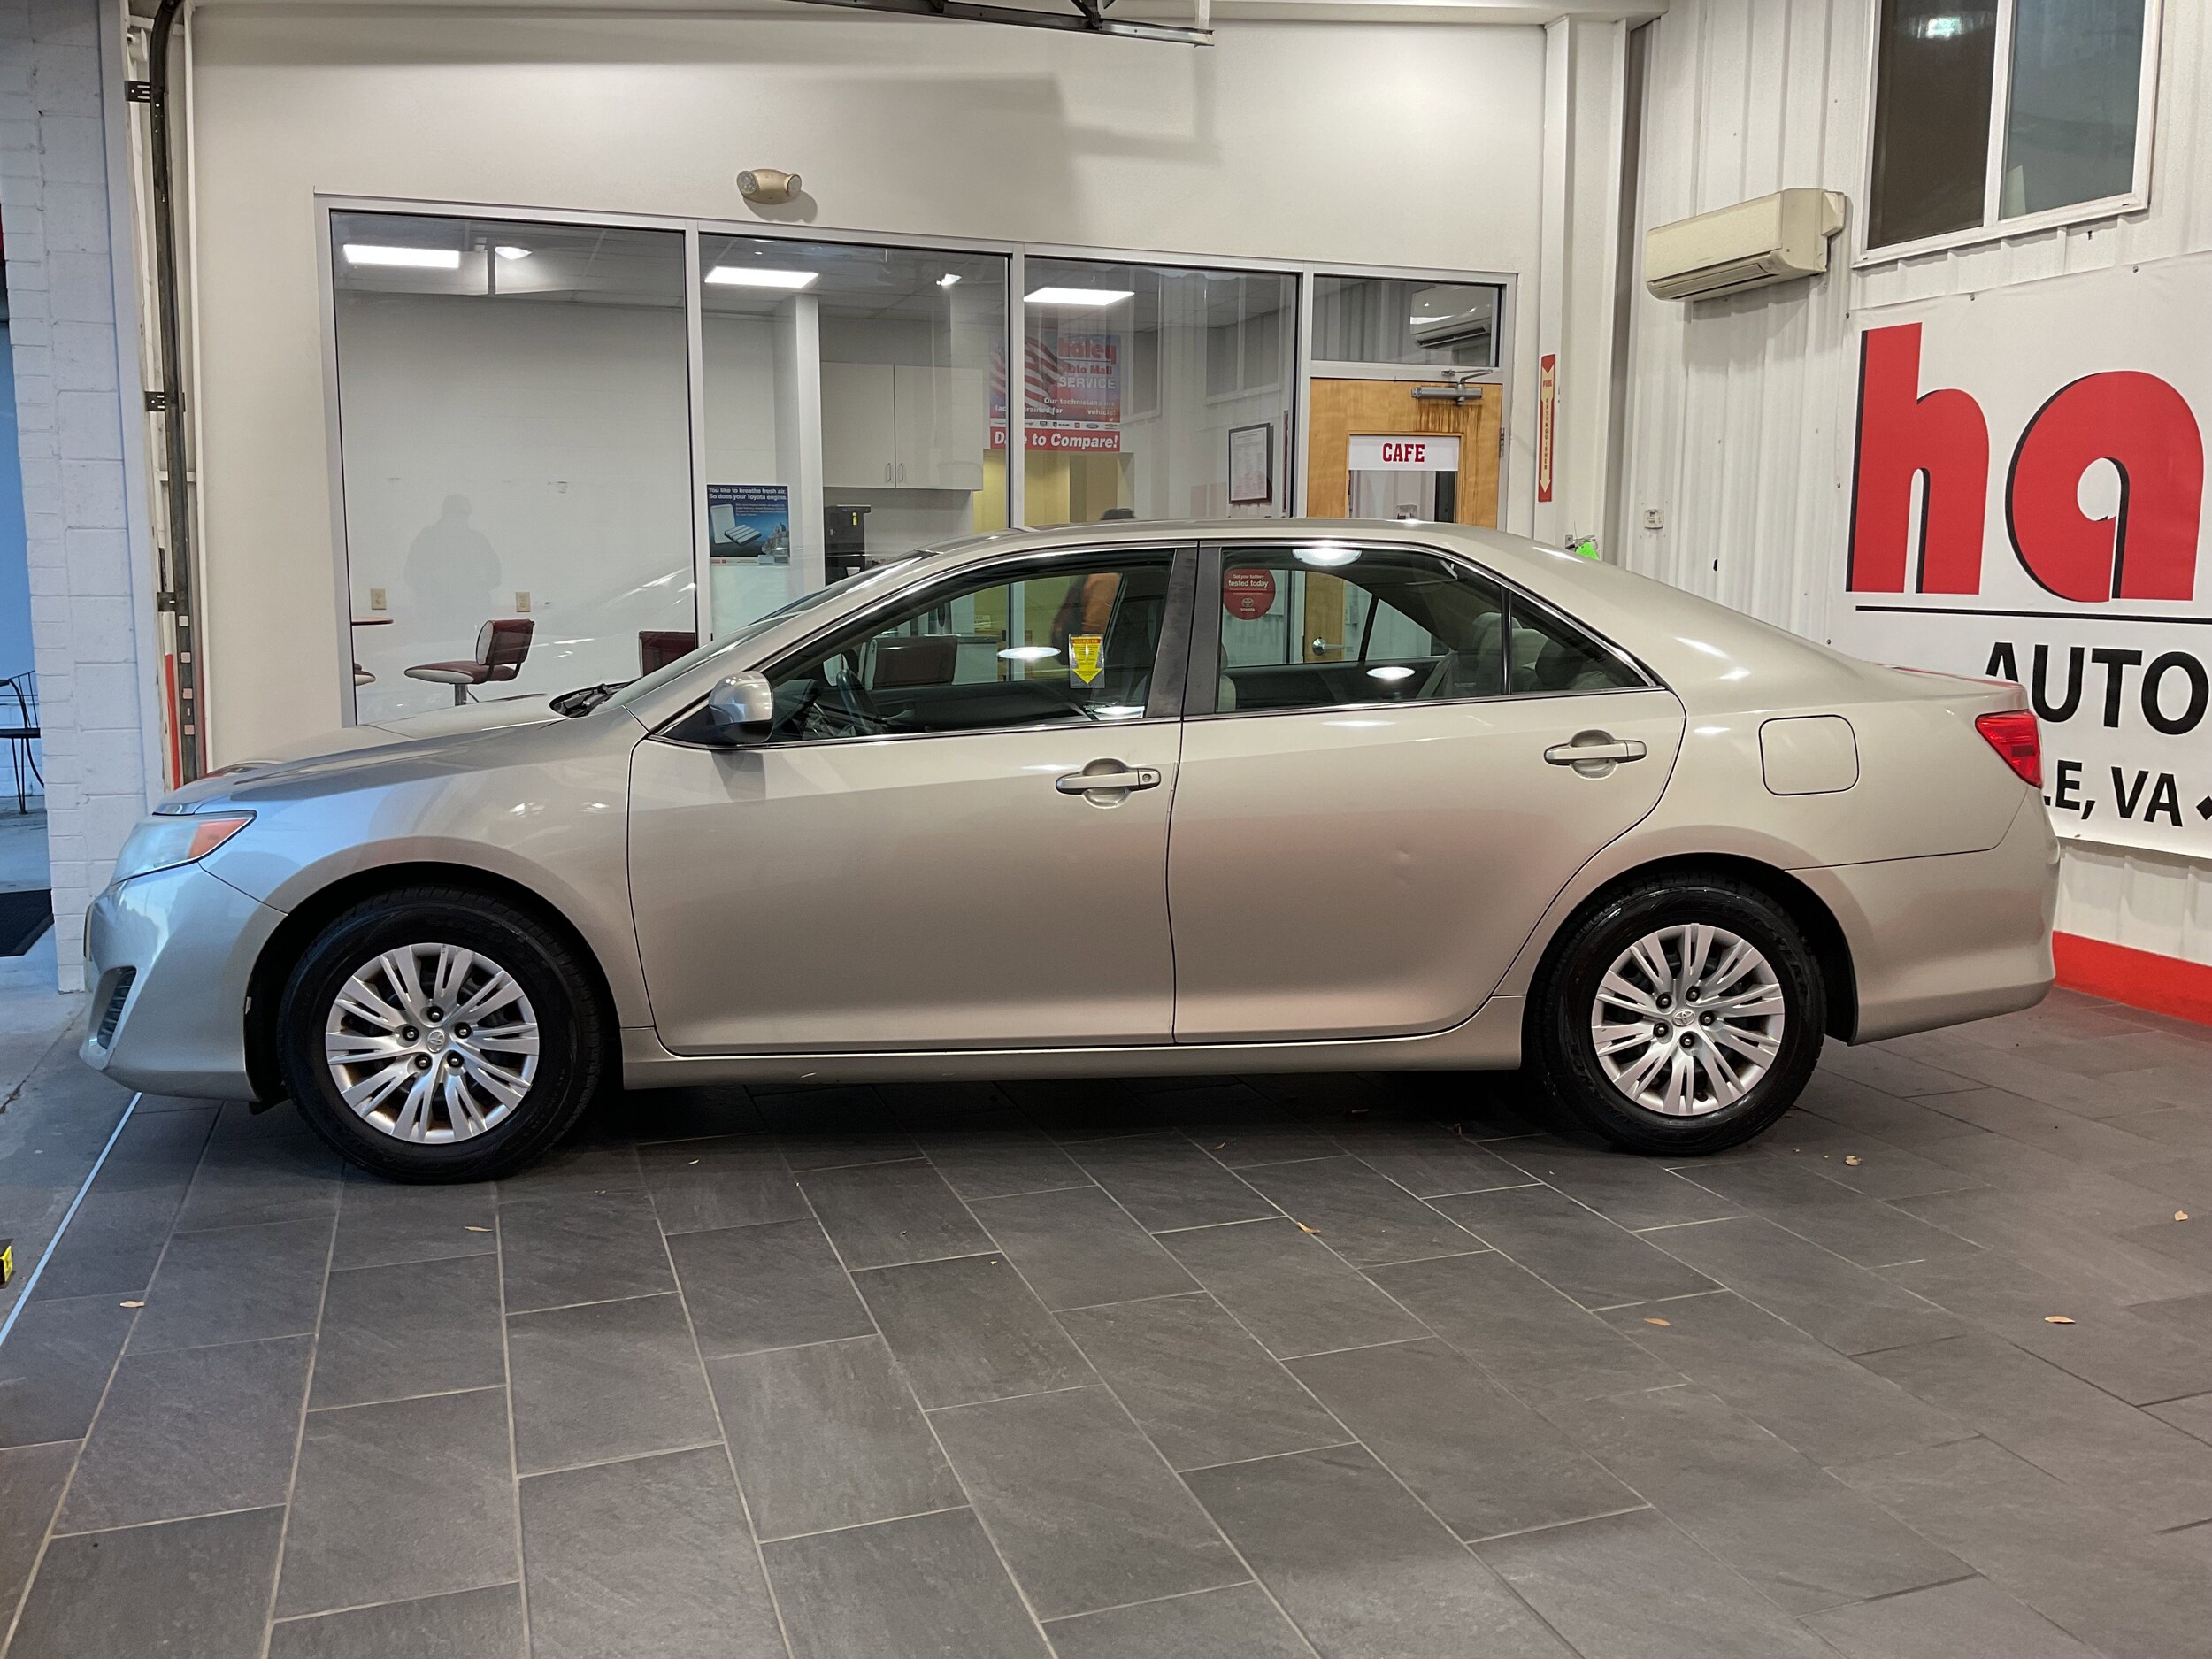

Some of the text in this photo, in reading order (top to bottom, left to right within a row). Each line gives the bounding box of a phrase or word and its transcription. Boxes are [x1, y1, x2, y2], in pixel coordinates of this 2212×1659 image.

[1058, 338, 1117, 365] haley
[1058, 376, 1116, 389] SERVICE
[1060, 397, 1102, 406] technicians
[1032, 433, 1047, 446] to
[1050, 433, 1118, 450] Compare!
[1382, 442, 1425, 463] CAFE
[1846, 322, 2204, 603] ha
[2043, 759, 2184, 827] E, VA
